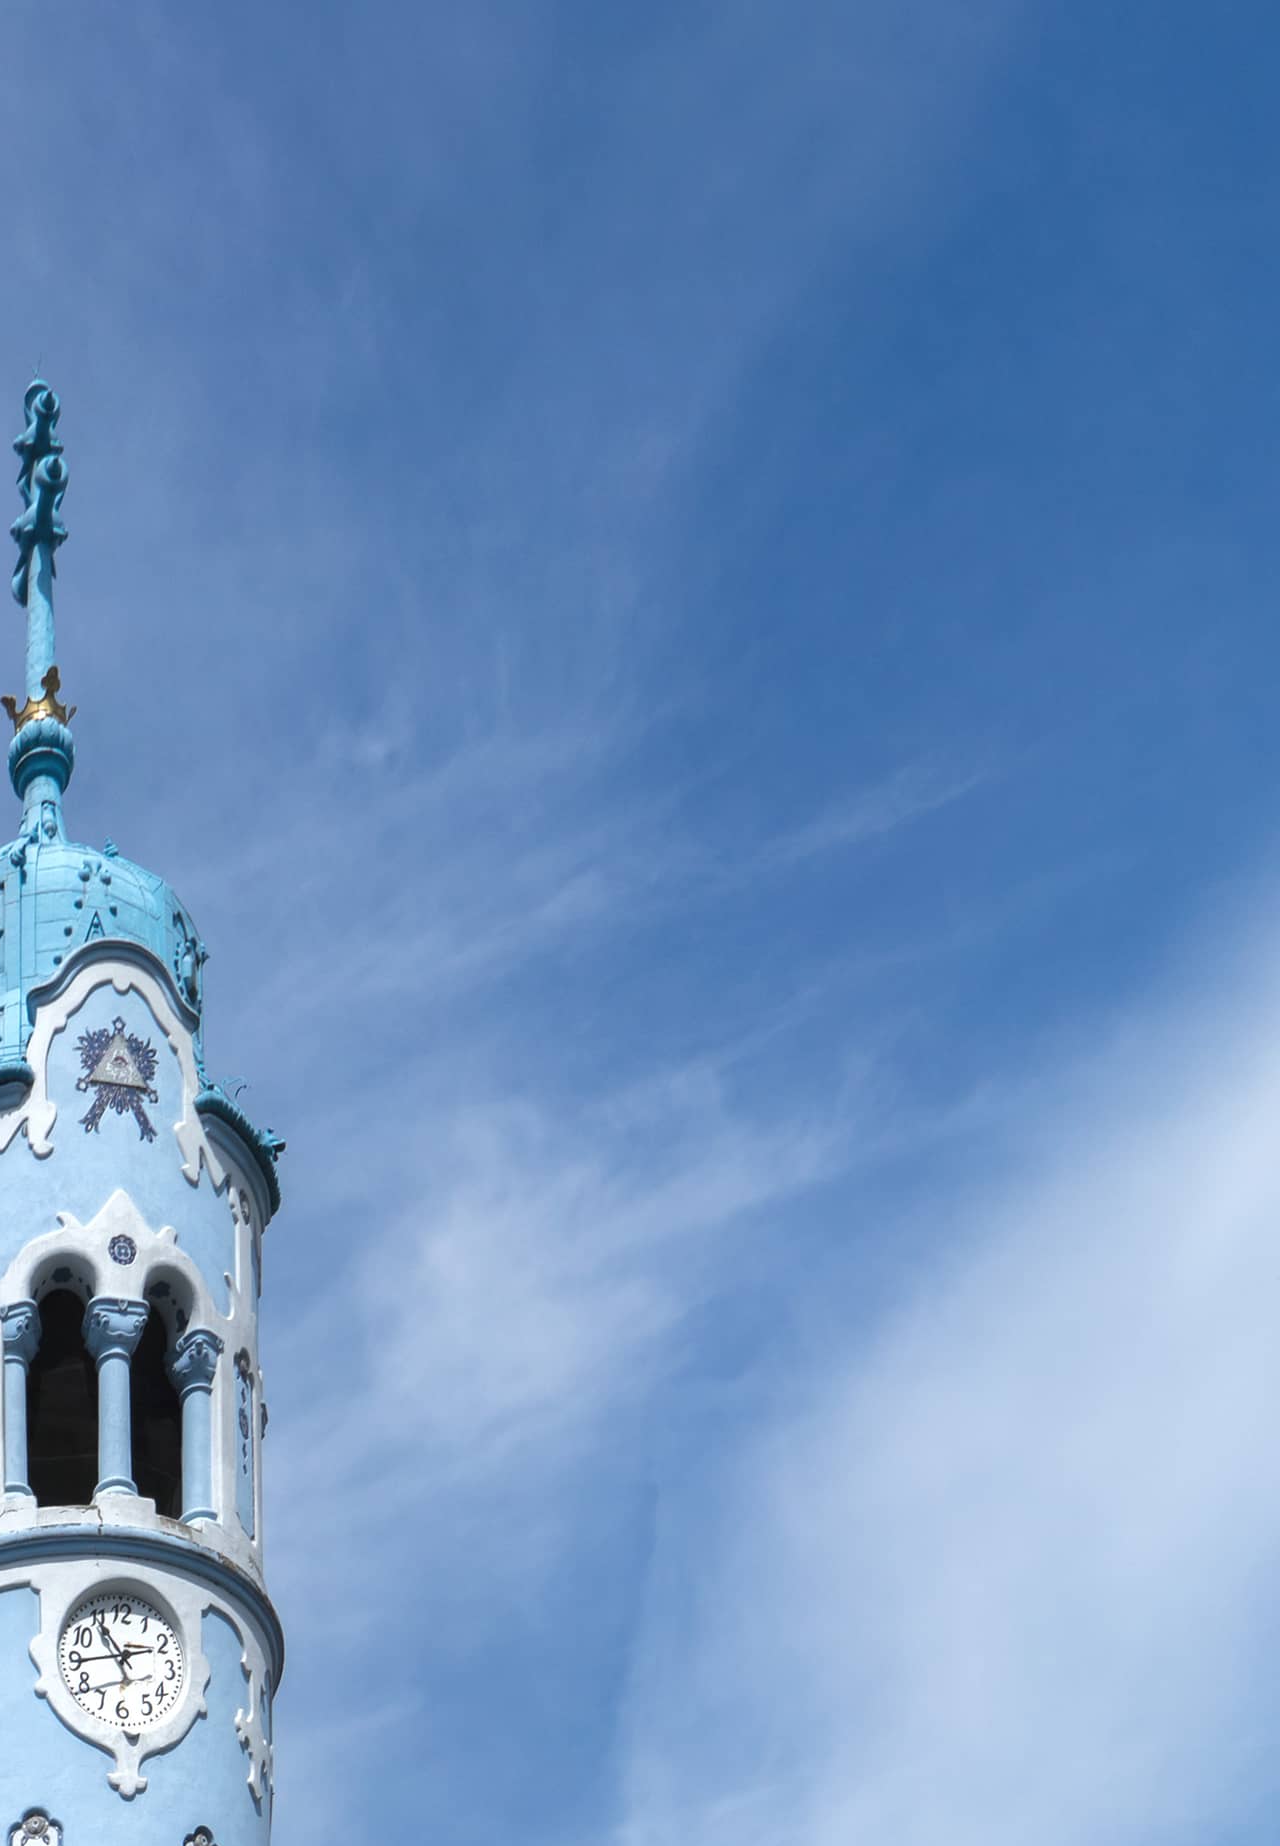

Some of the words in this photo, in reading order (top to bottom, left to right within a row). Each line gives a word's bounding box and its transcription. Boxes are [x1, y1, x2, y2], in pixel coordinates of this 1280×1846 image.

[91, 1608, 106, 1627] 11
[111, 1603, 132, 1625] 12
[141, 1616, 149, 1633] 1
[73, 1625, 93, 1648] 10
[156, 1633, 169, 1655] 2
[68, 1651, 82, 1671] 9
[164, 1660, 176, 1680] 3
[79, 1672, 90, 1693] 8
[94, 1688, 107, 1711] 7
[155, 1682, 168, 1706] 4
[116, 1700, 129, 1719] 6
[141, 1694, 153, 1716] 5
